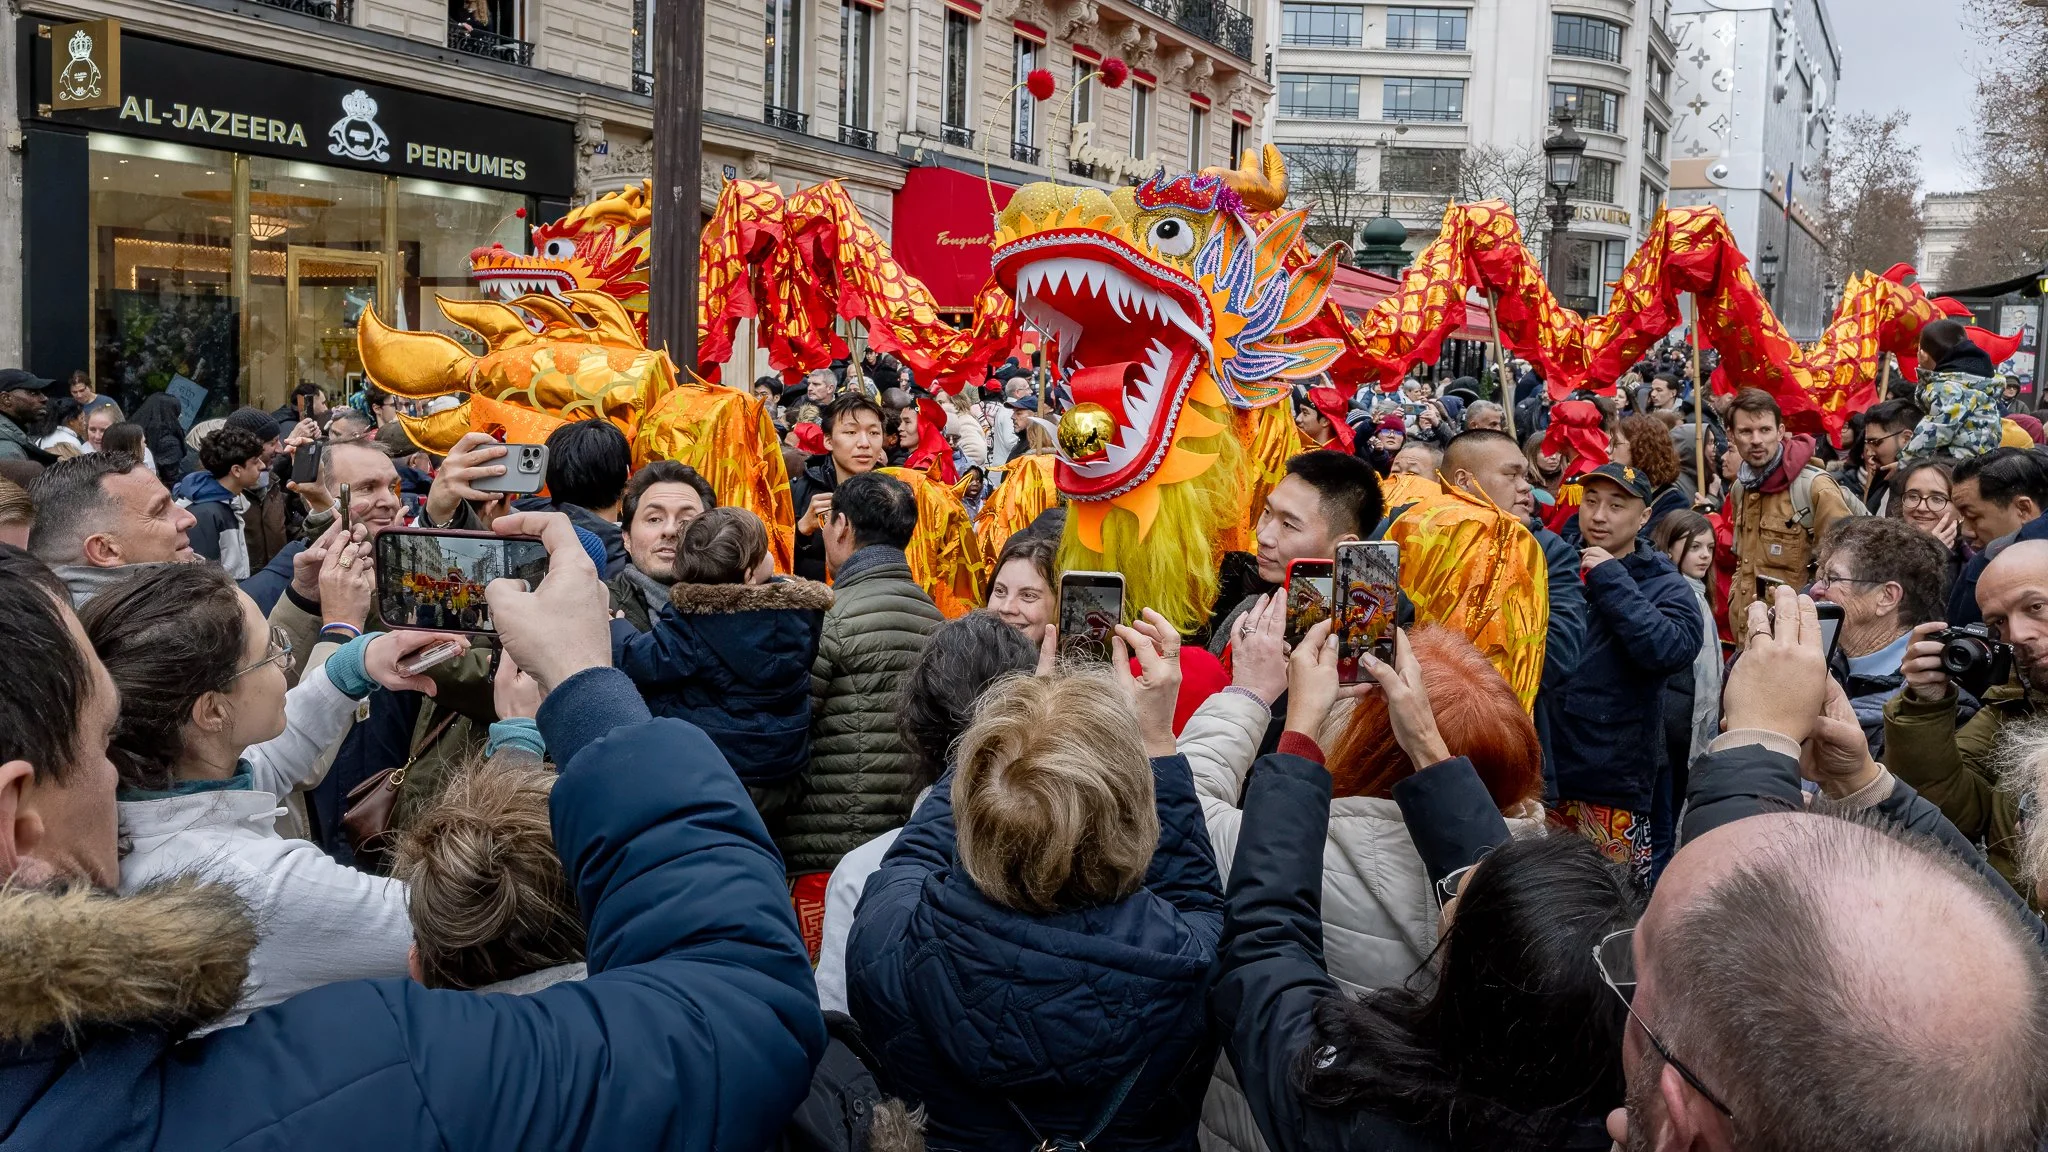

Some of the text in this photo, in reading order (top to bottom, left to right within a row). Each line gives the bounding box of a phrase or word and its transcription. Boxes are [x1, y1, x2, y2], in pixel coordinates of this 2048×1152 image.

[119, 95, 526, 181] AL-JAZEERA PERFUMES
[725, 167, 735, 179] 99
[936, 230, 996, 250] Fouquet
